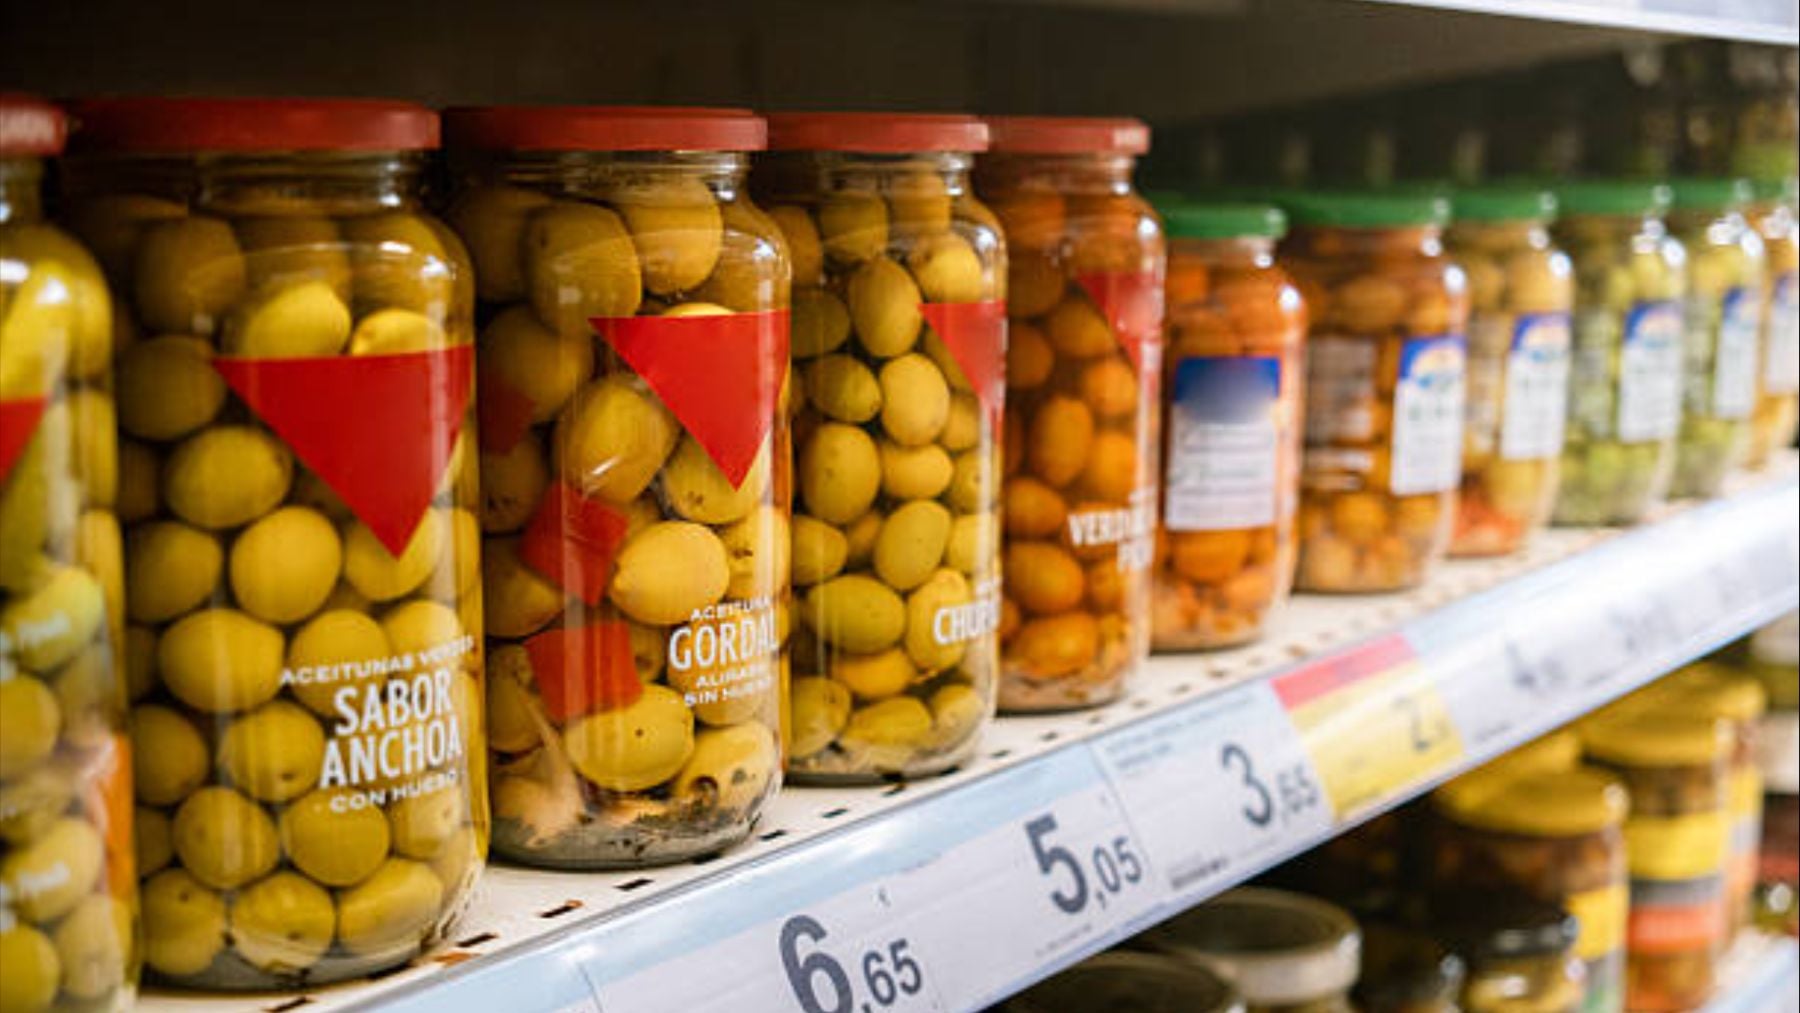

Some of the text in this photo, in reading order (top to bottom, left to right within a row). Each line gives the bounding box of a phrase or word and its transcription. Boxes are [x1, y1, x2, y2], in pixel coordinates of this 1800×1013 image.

[281, 654, 413, 683] ACEITUNAS
[669, 608, 778, 671] GORDAL
[333, 667, 452, 736] SABOR
[319, 714, 461, 790] ANCHOA
[329, 789, 386, 813] CON
[1024, 813, 1142, 915] 5,05
